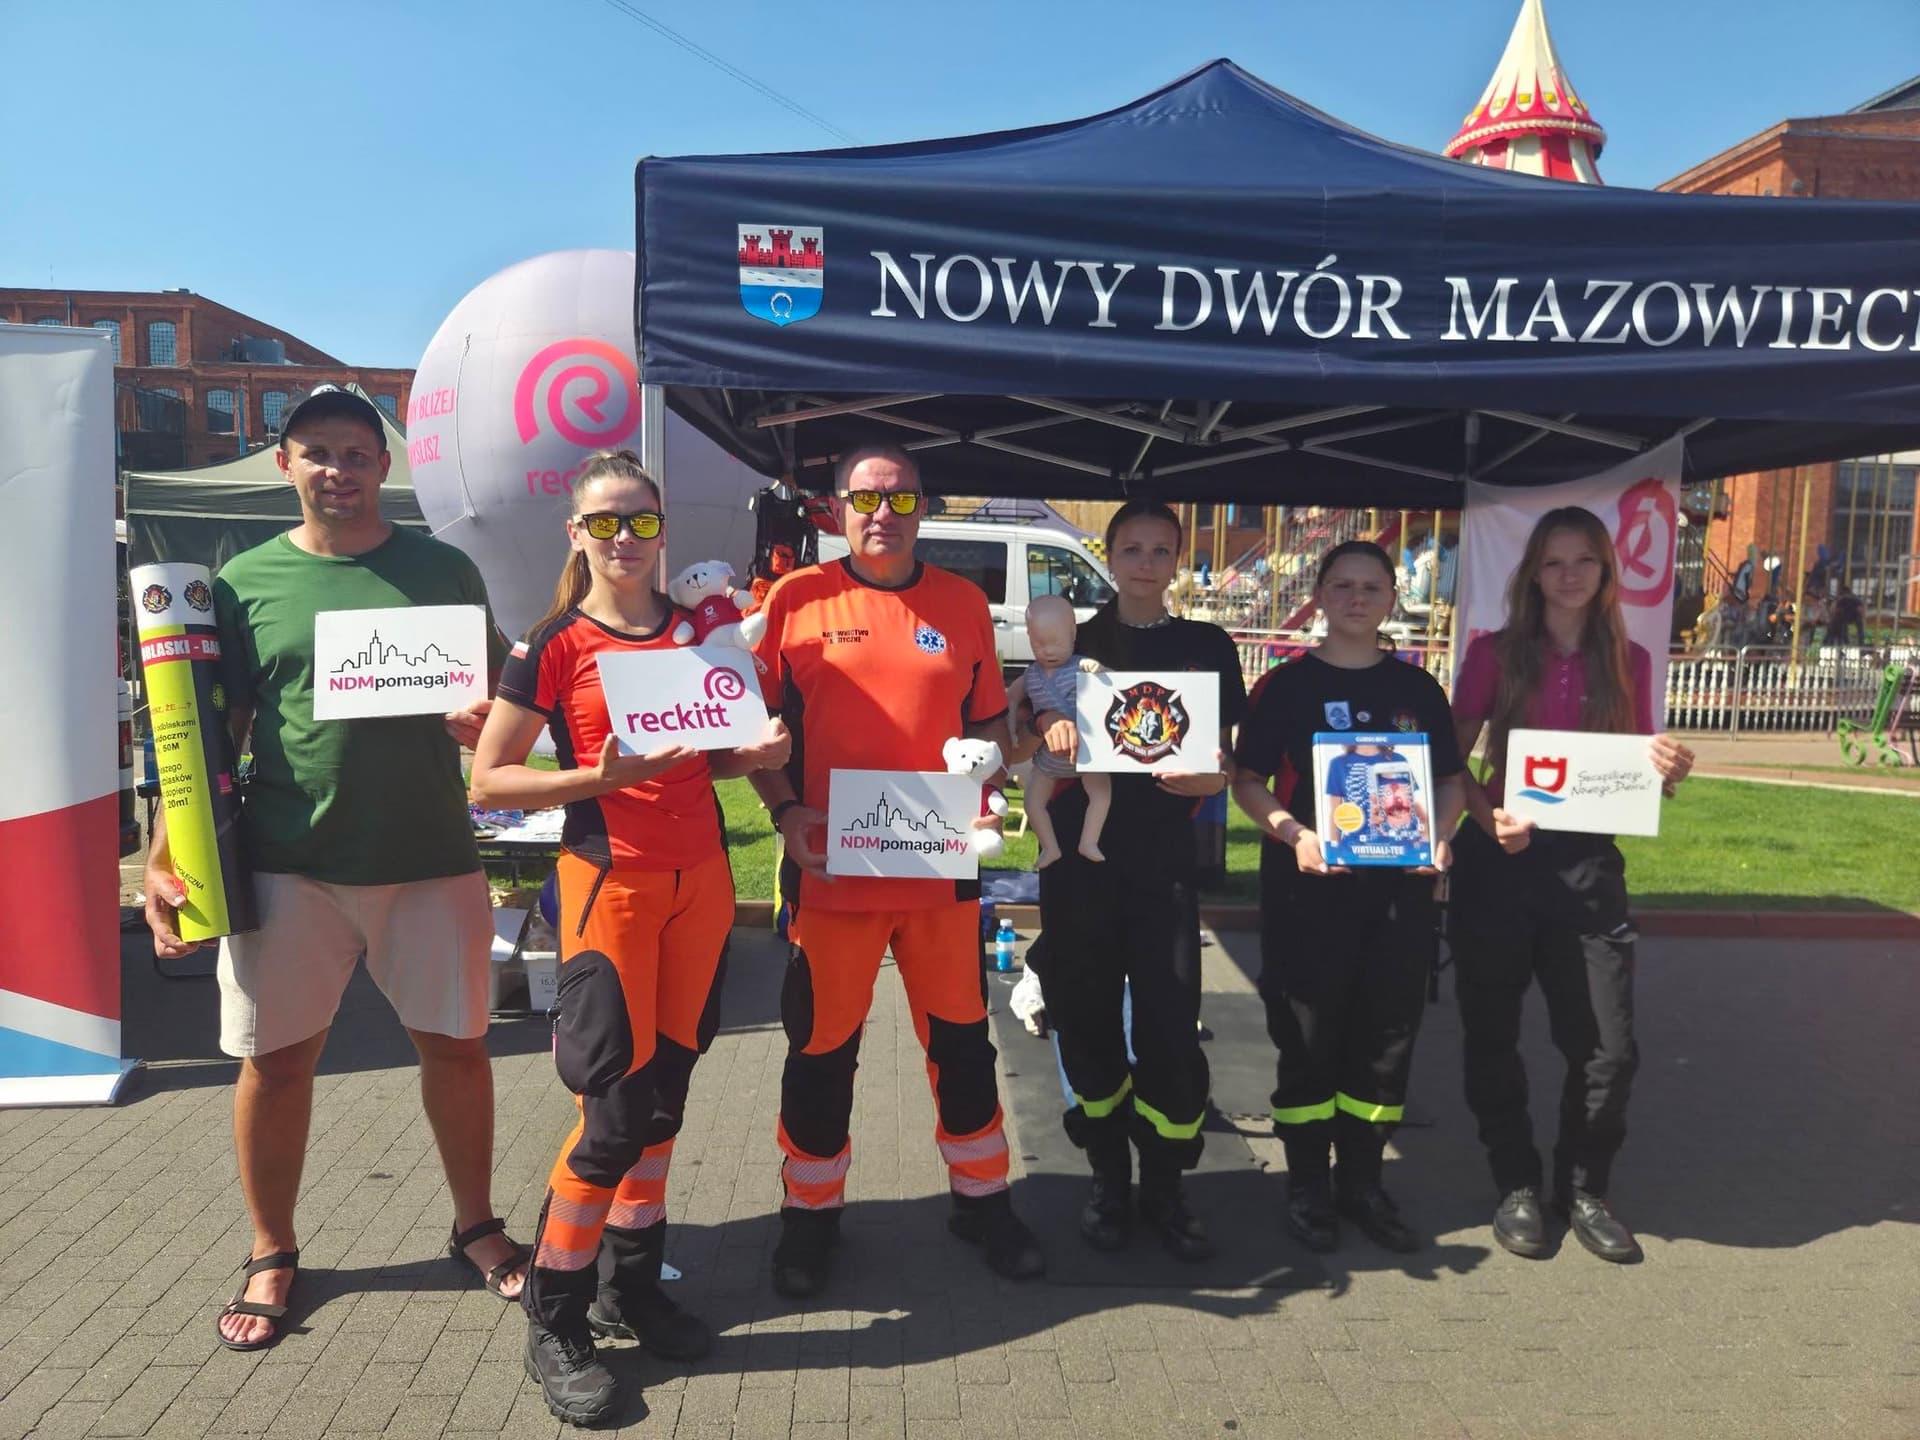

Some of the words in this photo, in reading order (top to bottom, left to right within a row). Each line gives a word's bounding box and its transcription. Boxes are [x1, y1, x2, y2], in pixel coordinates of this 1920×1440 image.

[870, 251, 1135, 328] NOWY
[1154, 254, 1411, 340] DWÓR
[329, 671, 475, 691] NDMpomagajMy
[626, 702, 731, 734] reckitt
[840, 835, 968, 856] NDMpomagajMy
